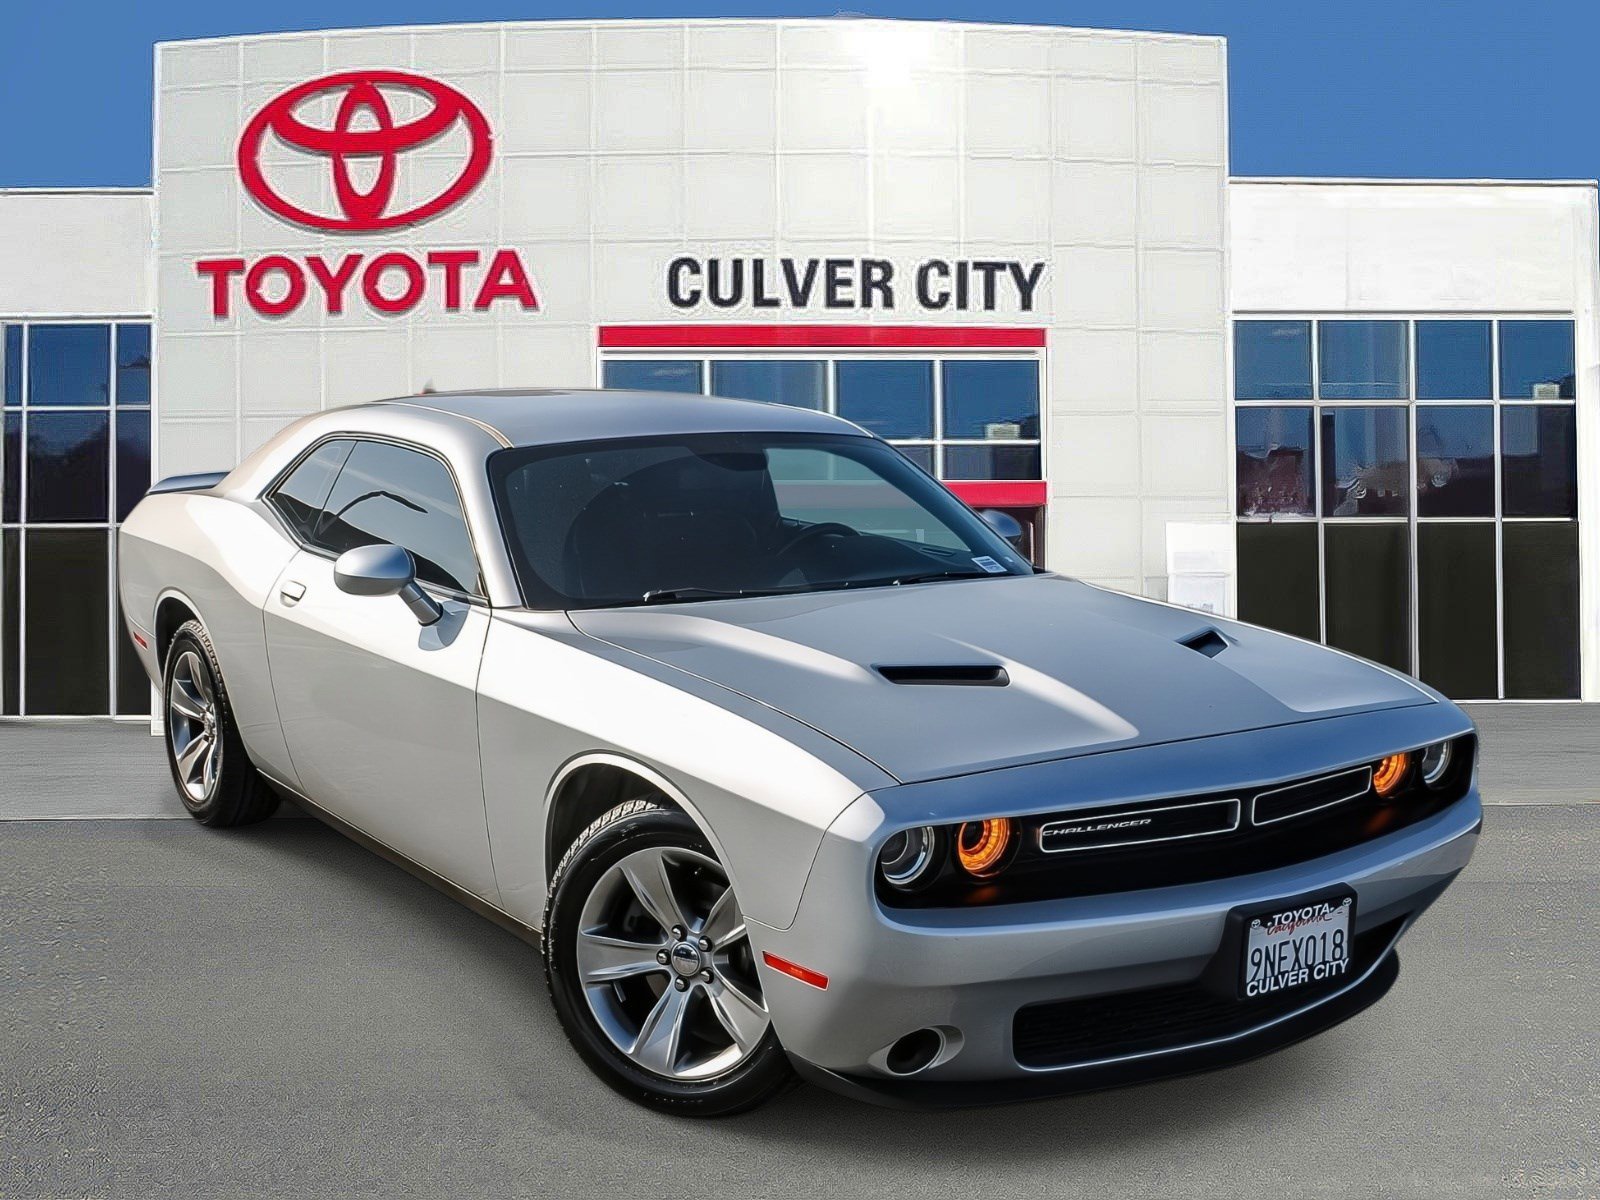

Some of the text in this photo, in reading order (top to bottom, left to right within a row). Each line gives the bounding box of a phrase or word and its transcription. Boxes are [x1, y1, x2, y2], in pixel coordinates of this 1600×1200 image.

[196, 249, 540, 319] TOYOTA
[667, 257, 1045, 312] CULVER CITY
[1042, 818, 1152, 837] CHALLENGER
[1273, 902, 1331, 927] TOYOTA
[1246, 958, 1350, 997] CULVER CITY
[1250, 928, 1345, 981] 9NEX018
